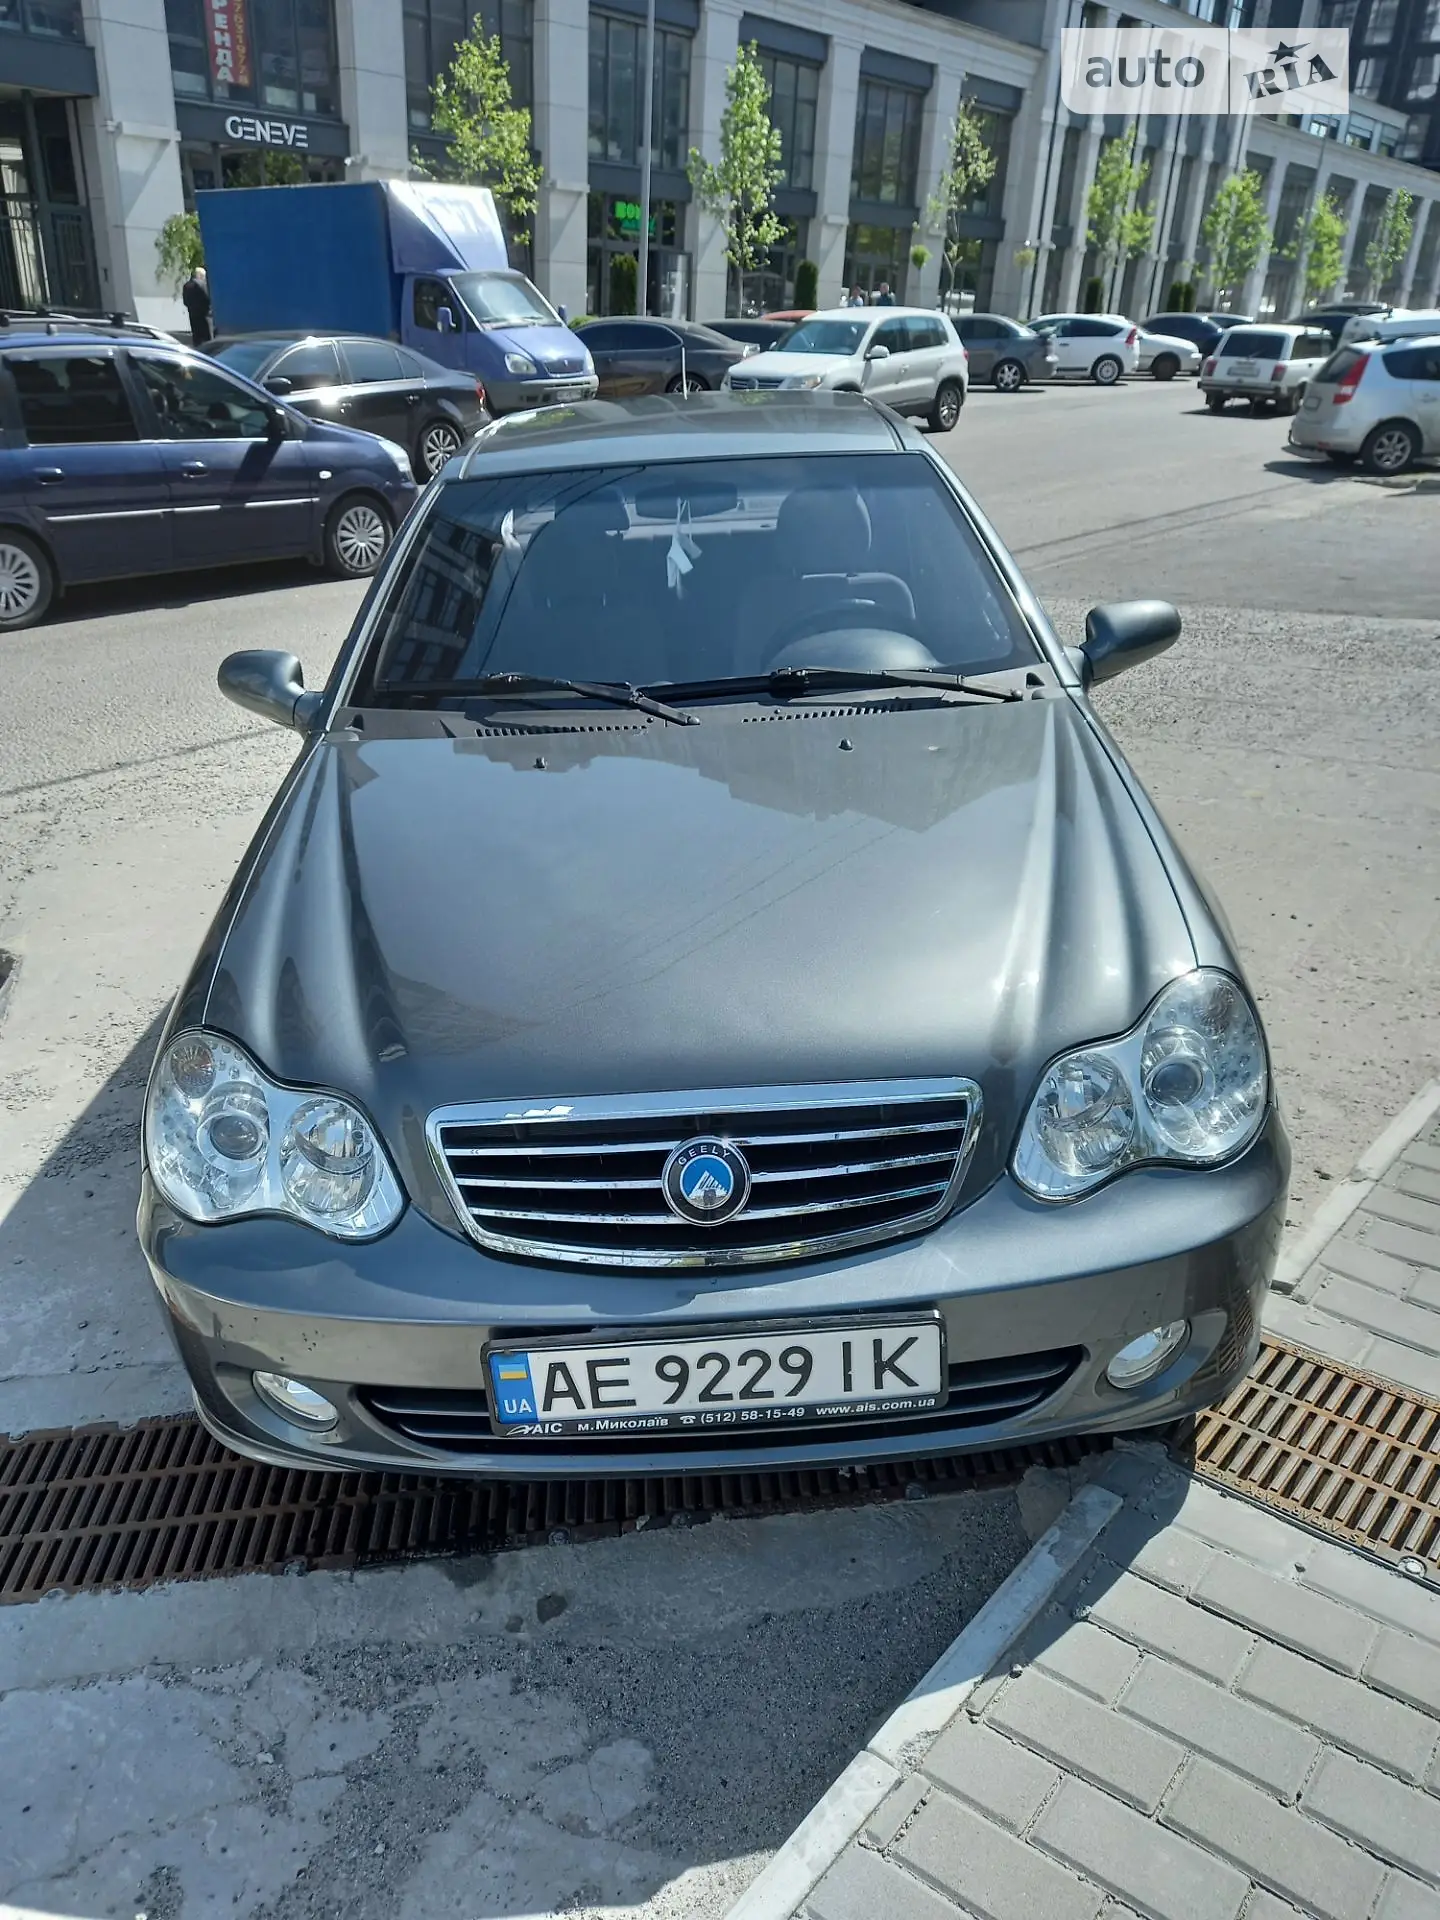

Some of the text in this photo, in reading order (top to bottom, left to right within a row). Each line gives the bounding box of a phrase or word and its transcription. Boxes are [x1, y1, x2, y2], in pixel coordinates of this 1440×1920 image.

[225, 115, 308, 148] GENEVE
[678, 1144, 731, 1166] GEELY
[542, 1336, 919, 1412] AE 9229 IK
[503, 1398, 533, 1415] UA
[700, 1411, 736, 1425] (512)
[740, 1407, 805, 1422] 58-15-49
[816, 1398, 936, 1417] www.ais.com.ua
